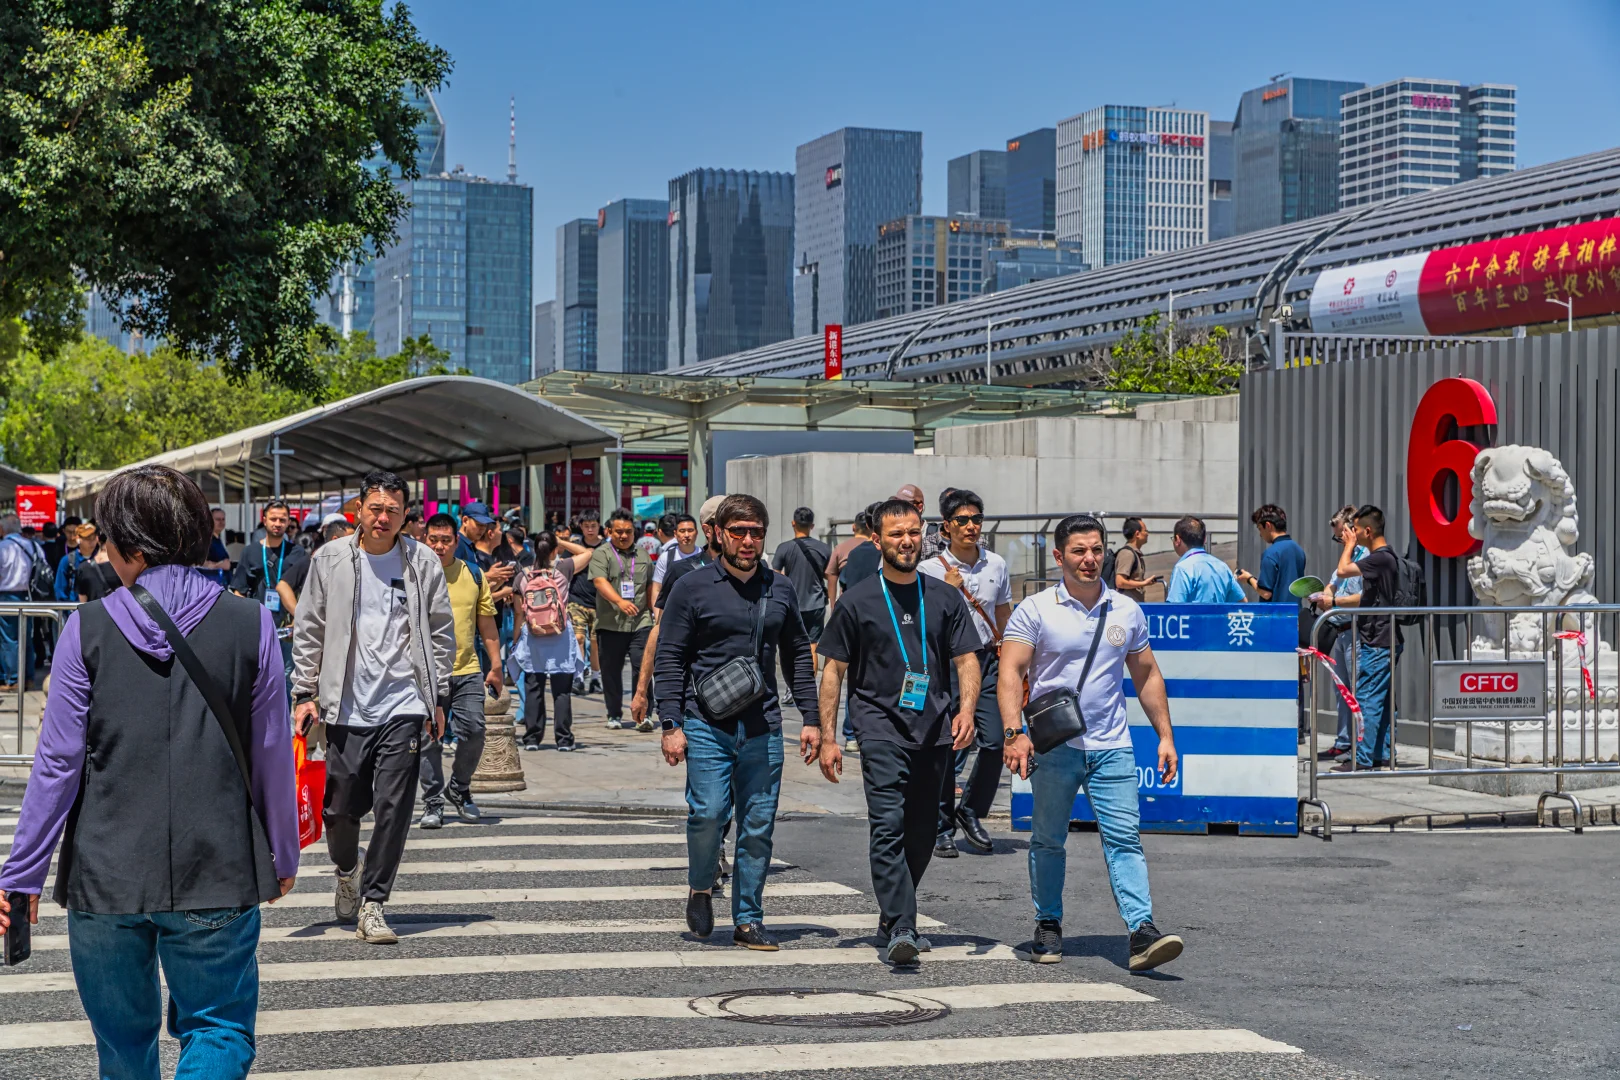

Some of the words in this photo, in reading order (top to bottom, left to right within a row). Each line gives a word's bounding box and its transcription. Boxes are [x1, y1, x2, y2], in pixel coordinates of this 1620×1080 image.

[1407, 377, 1498, 558] 6
[1147, 614, 1190, 639] LICE
[1227, 609, 1255, 647] 察
[1463, 674, 1515, 692] CFTC
